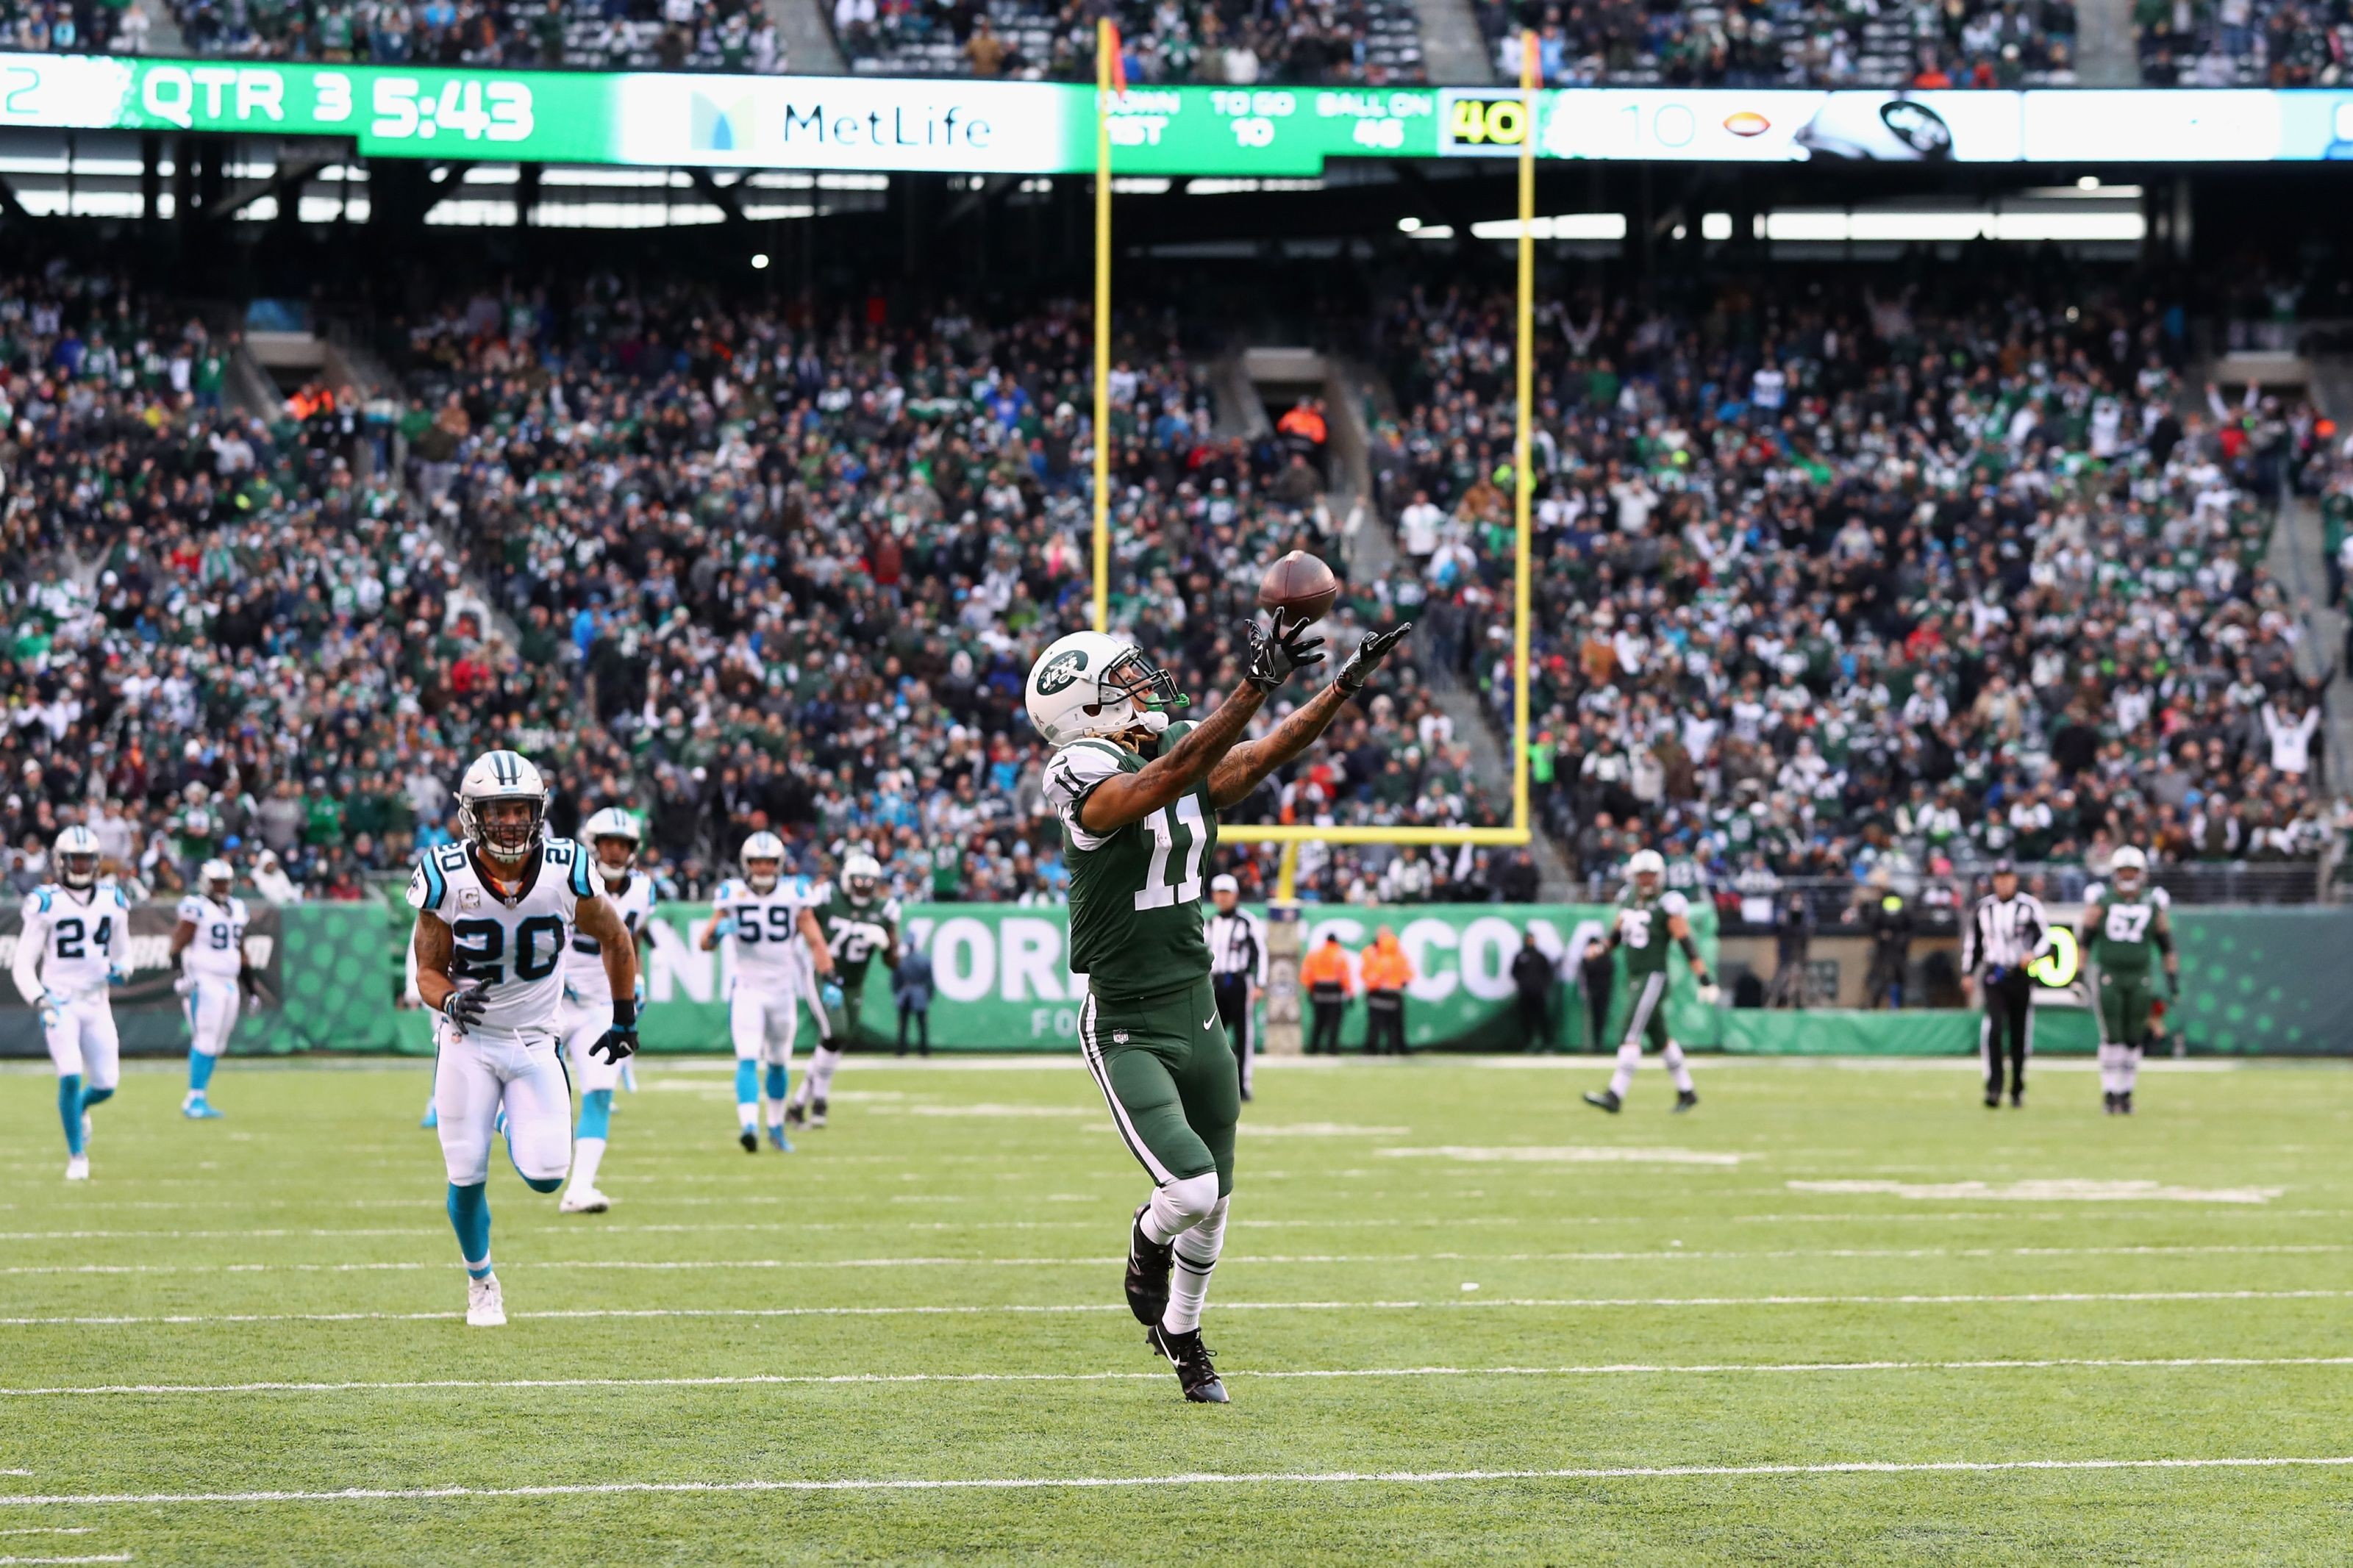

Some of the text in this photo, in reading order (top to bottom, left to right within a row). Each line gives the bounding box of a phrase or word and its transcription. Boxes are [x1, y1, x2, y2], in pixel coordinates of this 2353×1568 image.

[143, 67, 353, 129] QTR 3
[371, 78, 535, 142] 5:43
[785, 104, 990, 148] MetLife
[1230, 118, 1275, 147] 10
[1452, 100, 1527, 144] 40
[1054, 765, 1088, 800] 11
[1135, 792, 1207, 911] 11
[56, 917, 111, 958] 24
[737, 906, 790, 943] 59
[827, 916, 875, 963] 72
[453, 914, 565, 984] 20
